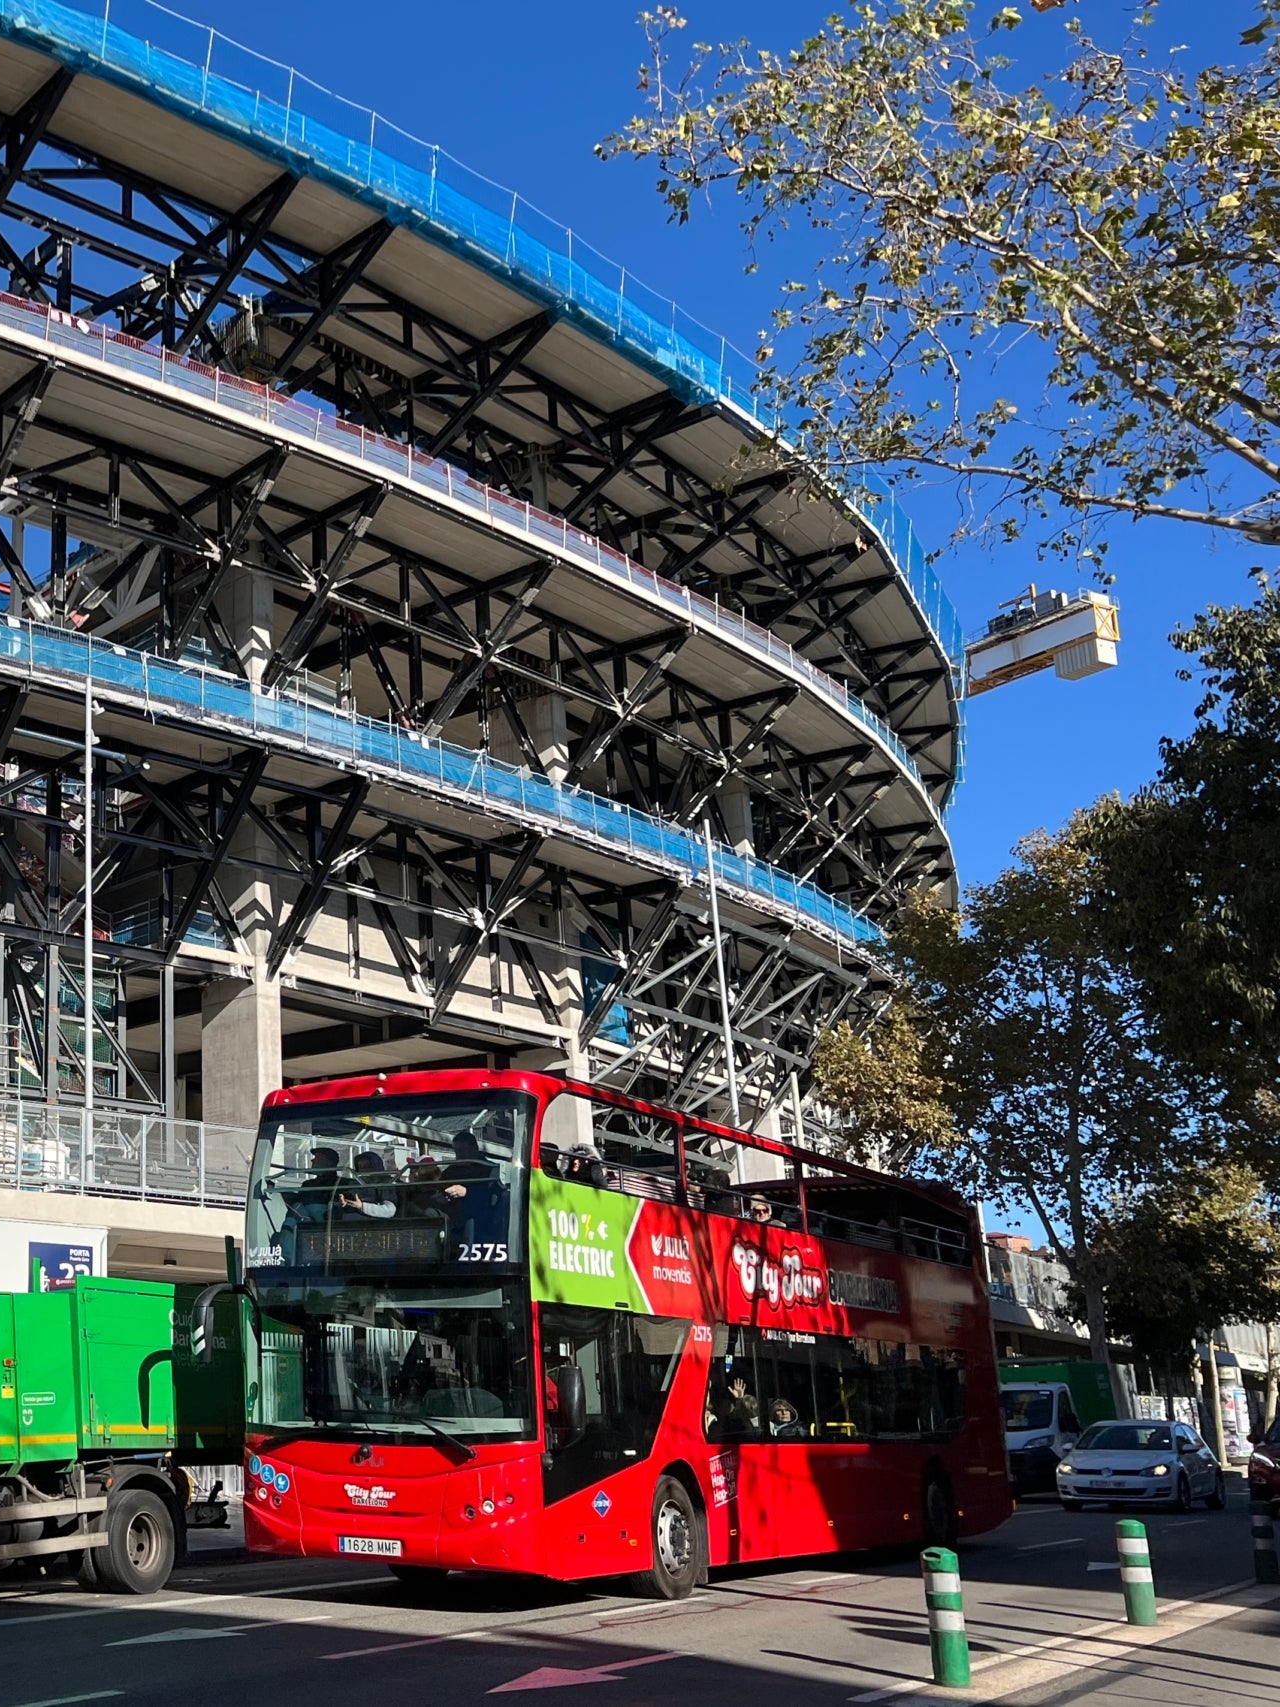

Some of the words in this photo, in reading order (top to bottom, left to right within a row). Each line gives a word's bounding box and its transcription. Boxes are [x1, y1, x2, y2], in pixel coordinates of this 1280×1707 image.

[548, 1209, 579, 1240] 100
[69, 1248, 90, 1257] PORTA
[458, 1243, 508, 1262] 2575
[549, 1240, 616, 1279] ELECTRIC
[653, 1266, 692, 1285] moventis
[732, 1242, 779, 1304] City
[781, 1254, 822, 1301] Tour
[692, 1325, 712, 1342] 2575
[344, 1483, 369, 1499] City
[370, 1485, 396, 1499] Tour
[352, 1497, 388, 1508] BARCELONA
[348, 1539, 374, 1553] 1628
[377, 1541, 398, 1554] MMF
